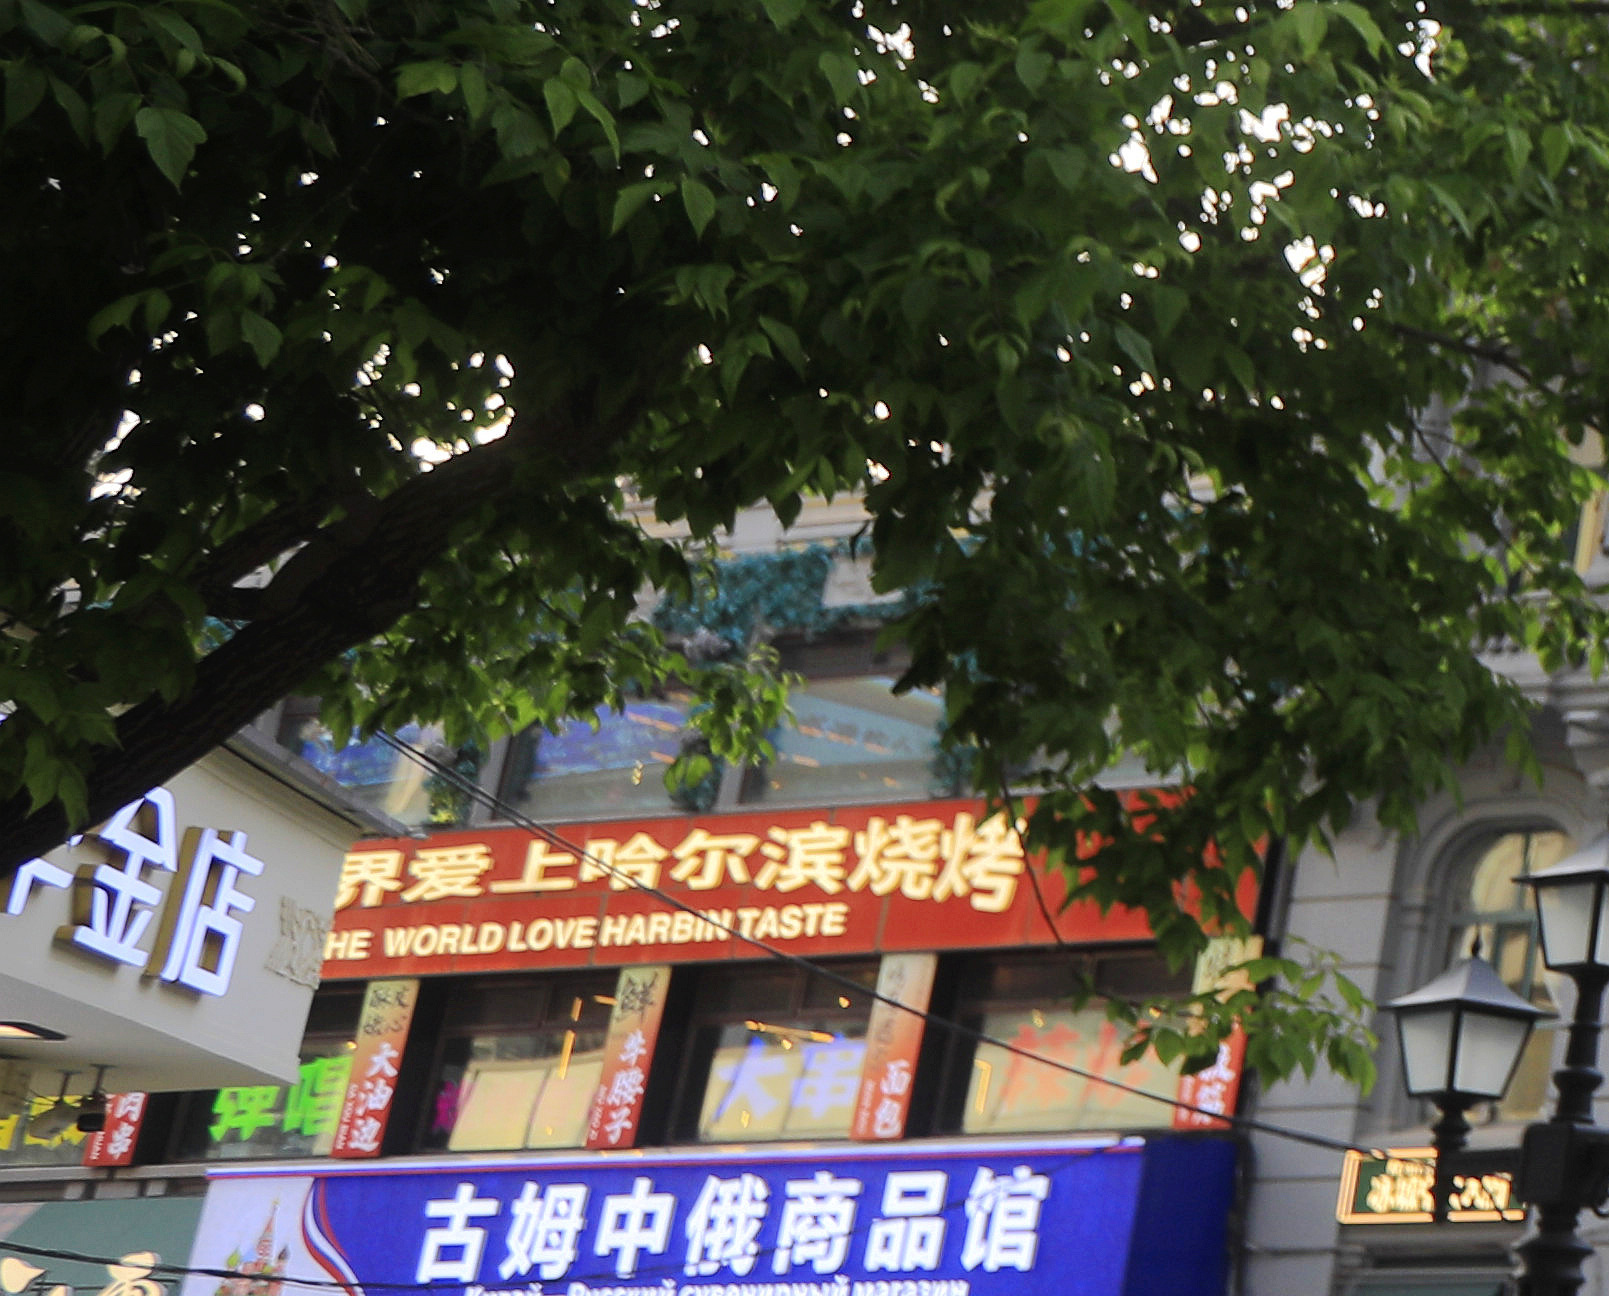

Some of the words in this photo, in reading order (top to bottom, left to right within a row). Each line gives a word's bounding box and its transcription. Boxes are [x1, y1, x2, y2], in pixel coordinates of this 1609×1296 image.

[335, 811, 1026, 913] 界爱上哈尔滨烧烤
[325, 931, 370, 961] HE
[384, 923, 504, 959] WORLD
[507, 916, 598, 952] LOVE
[601, 908, 735, 948] HARBIN
[737, 903, 849, 940] TASTE
[414, 1165, 1051, 1284] 古姆中俄商品馆
